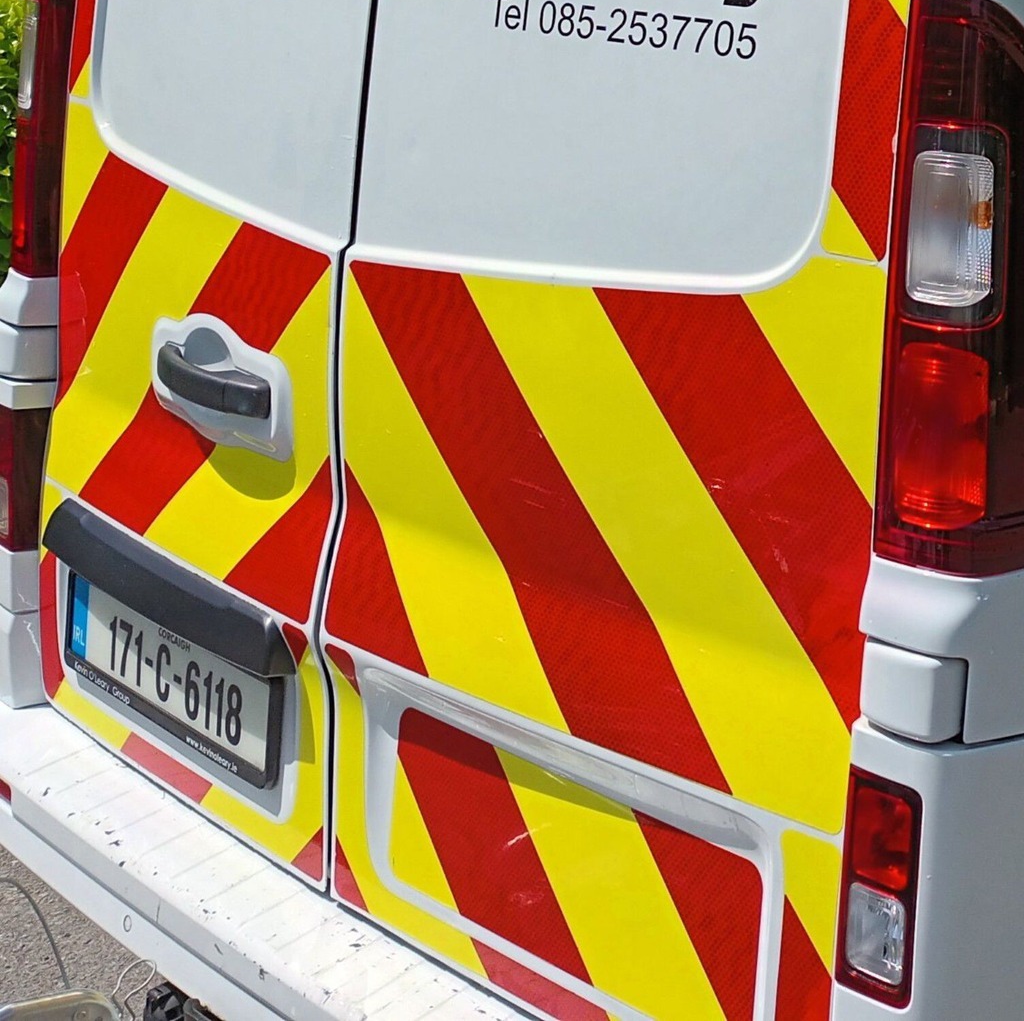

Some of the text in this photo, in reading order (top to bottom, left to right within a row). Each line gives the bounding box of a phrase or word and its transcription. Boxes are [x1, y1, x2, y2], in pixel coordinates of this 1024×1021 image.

[540, 1, 757, 59] 085-2537705
[73, 624, 85, 646] IRL
[158, 628, 191, 653] CORCAIGH
[74, 661, 89, 677] Kevin
[112, 686, 131, 705] Group
[110, 616, 242, 746] 171-C-6118
